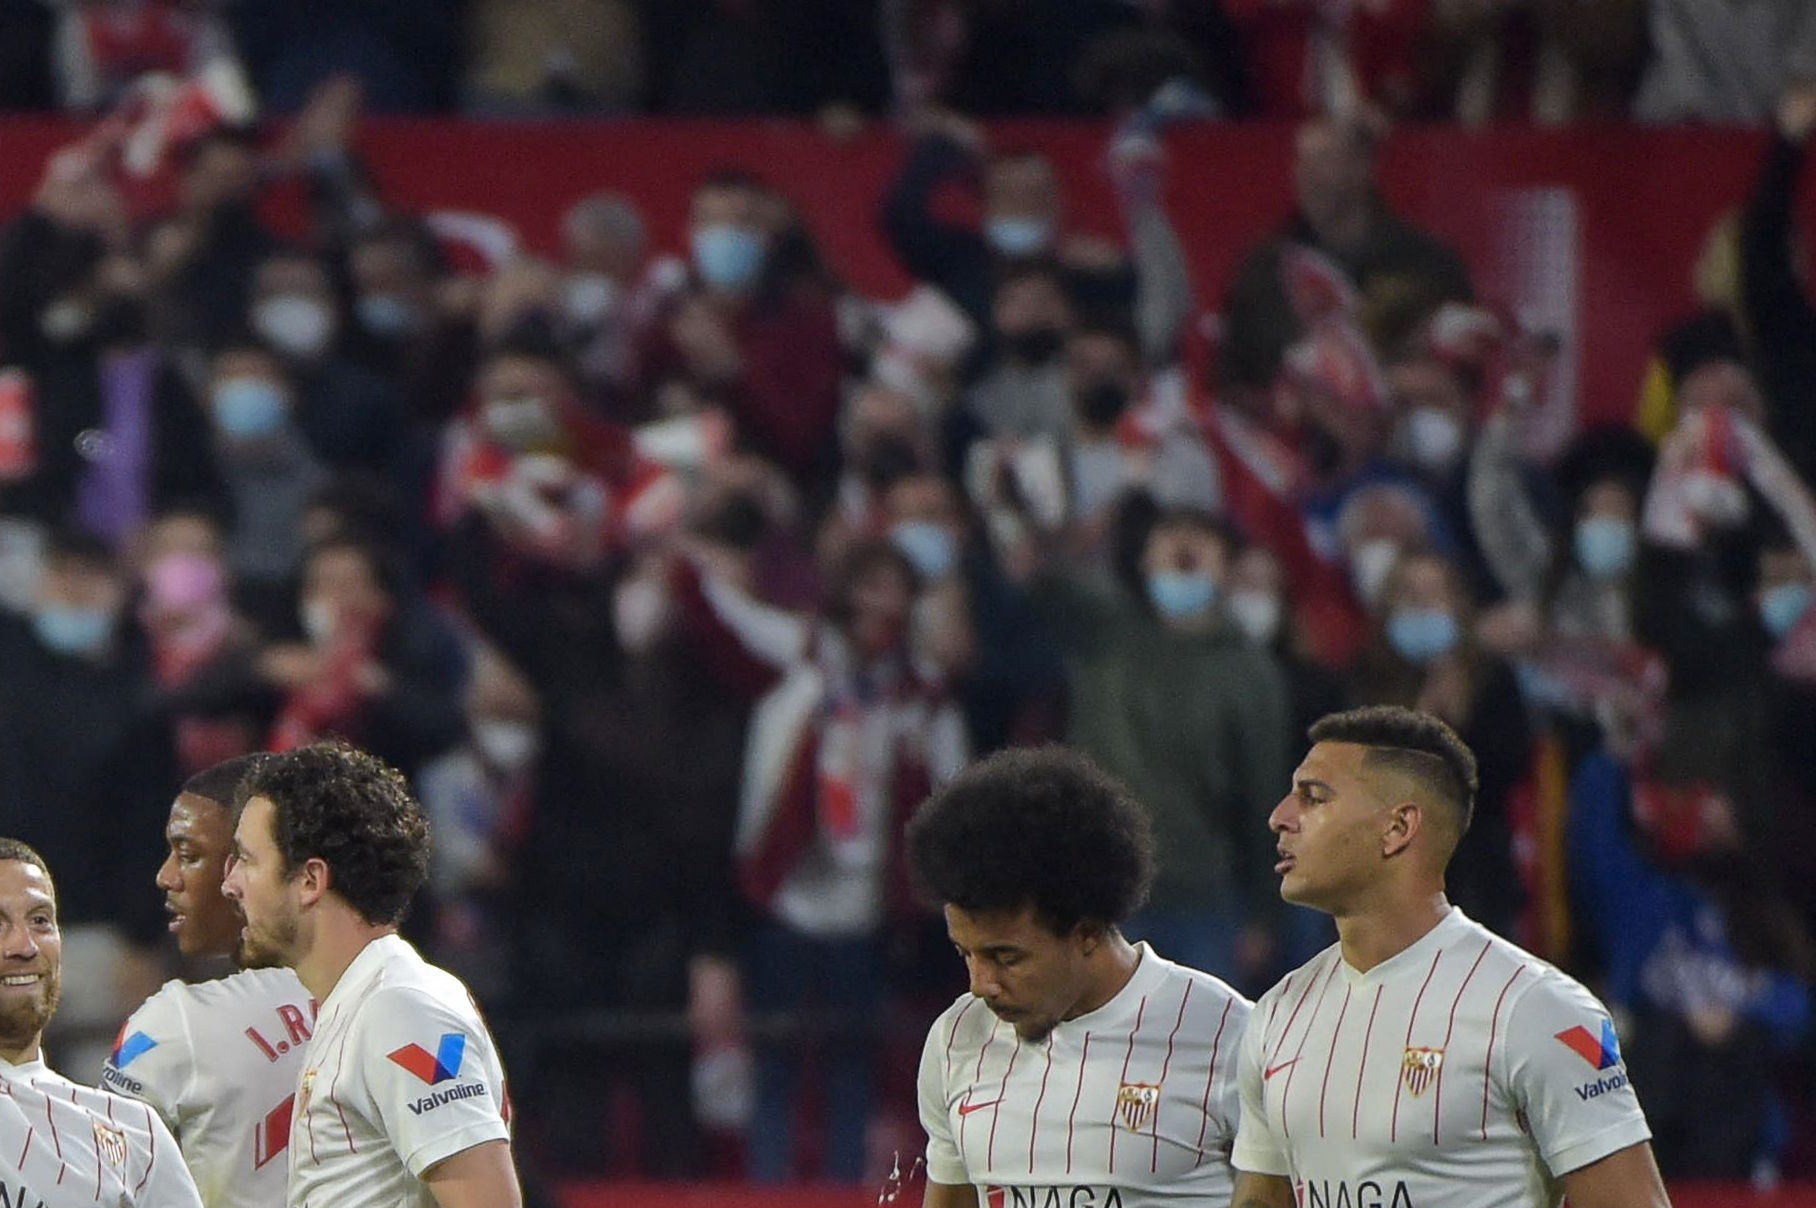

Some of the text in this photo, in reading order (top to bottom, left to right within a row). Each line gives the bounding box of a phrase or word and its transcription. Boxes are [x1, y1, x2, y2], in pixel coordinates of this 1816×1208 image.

[102, 1066, 142, 1095] oline
[1575, 1074, 1627, 1101] Valvo
[407, 1083, 486, 1115] Valvoline
